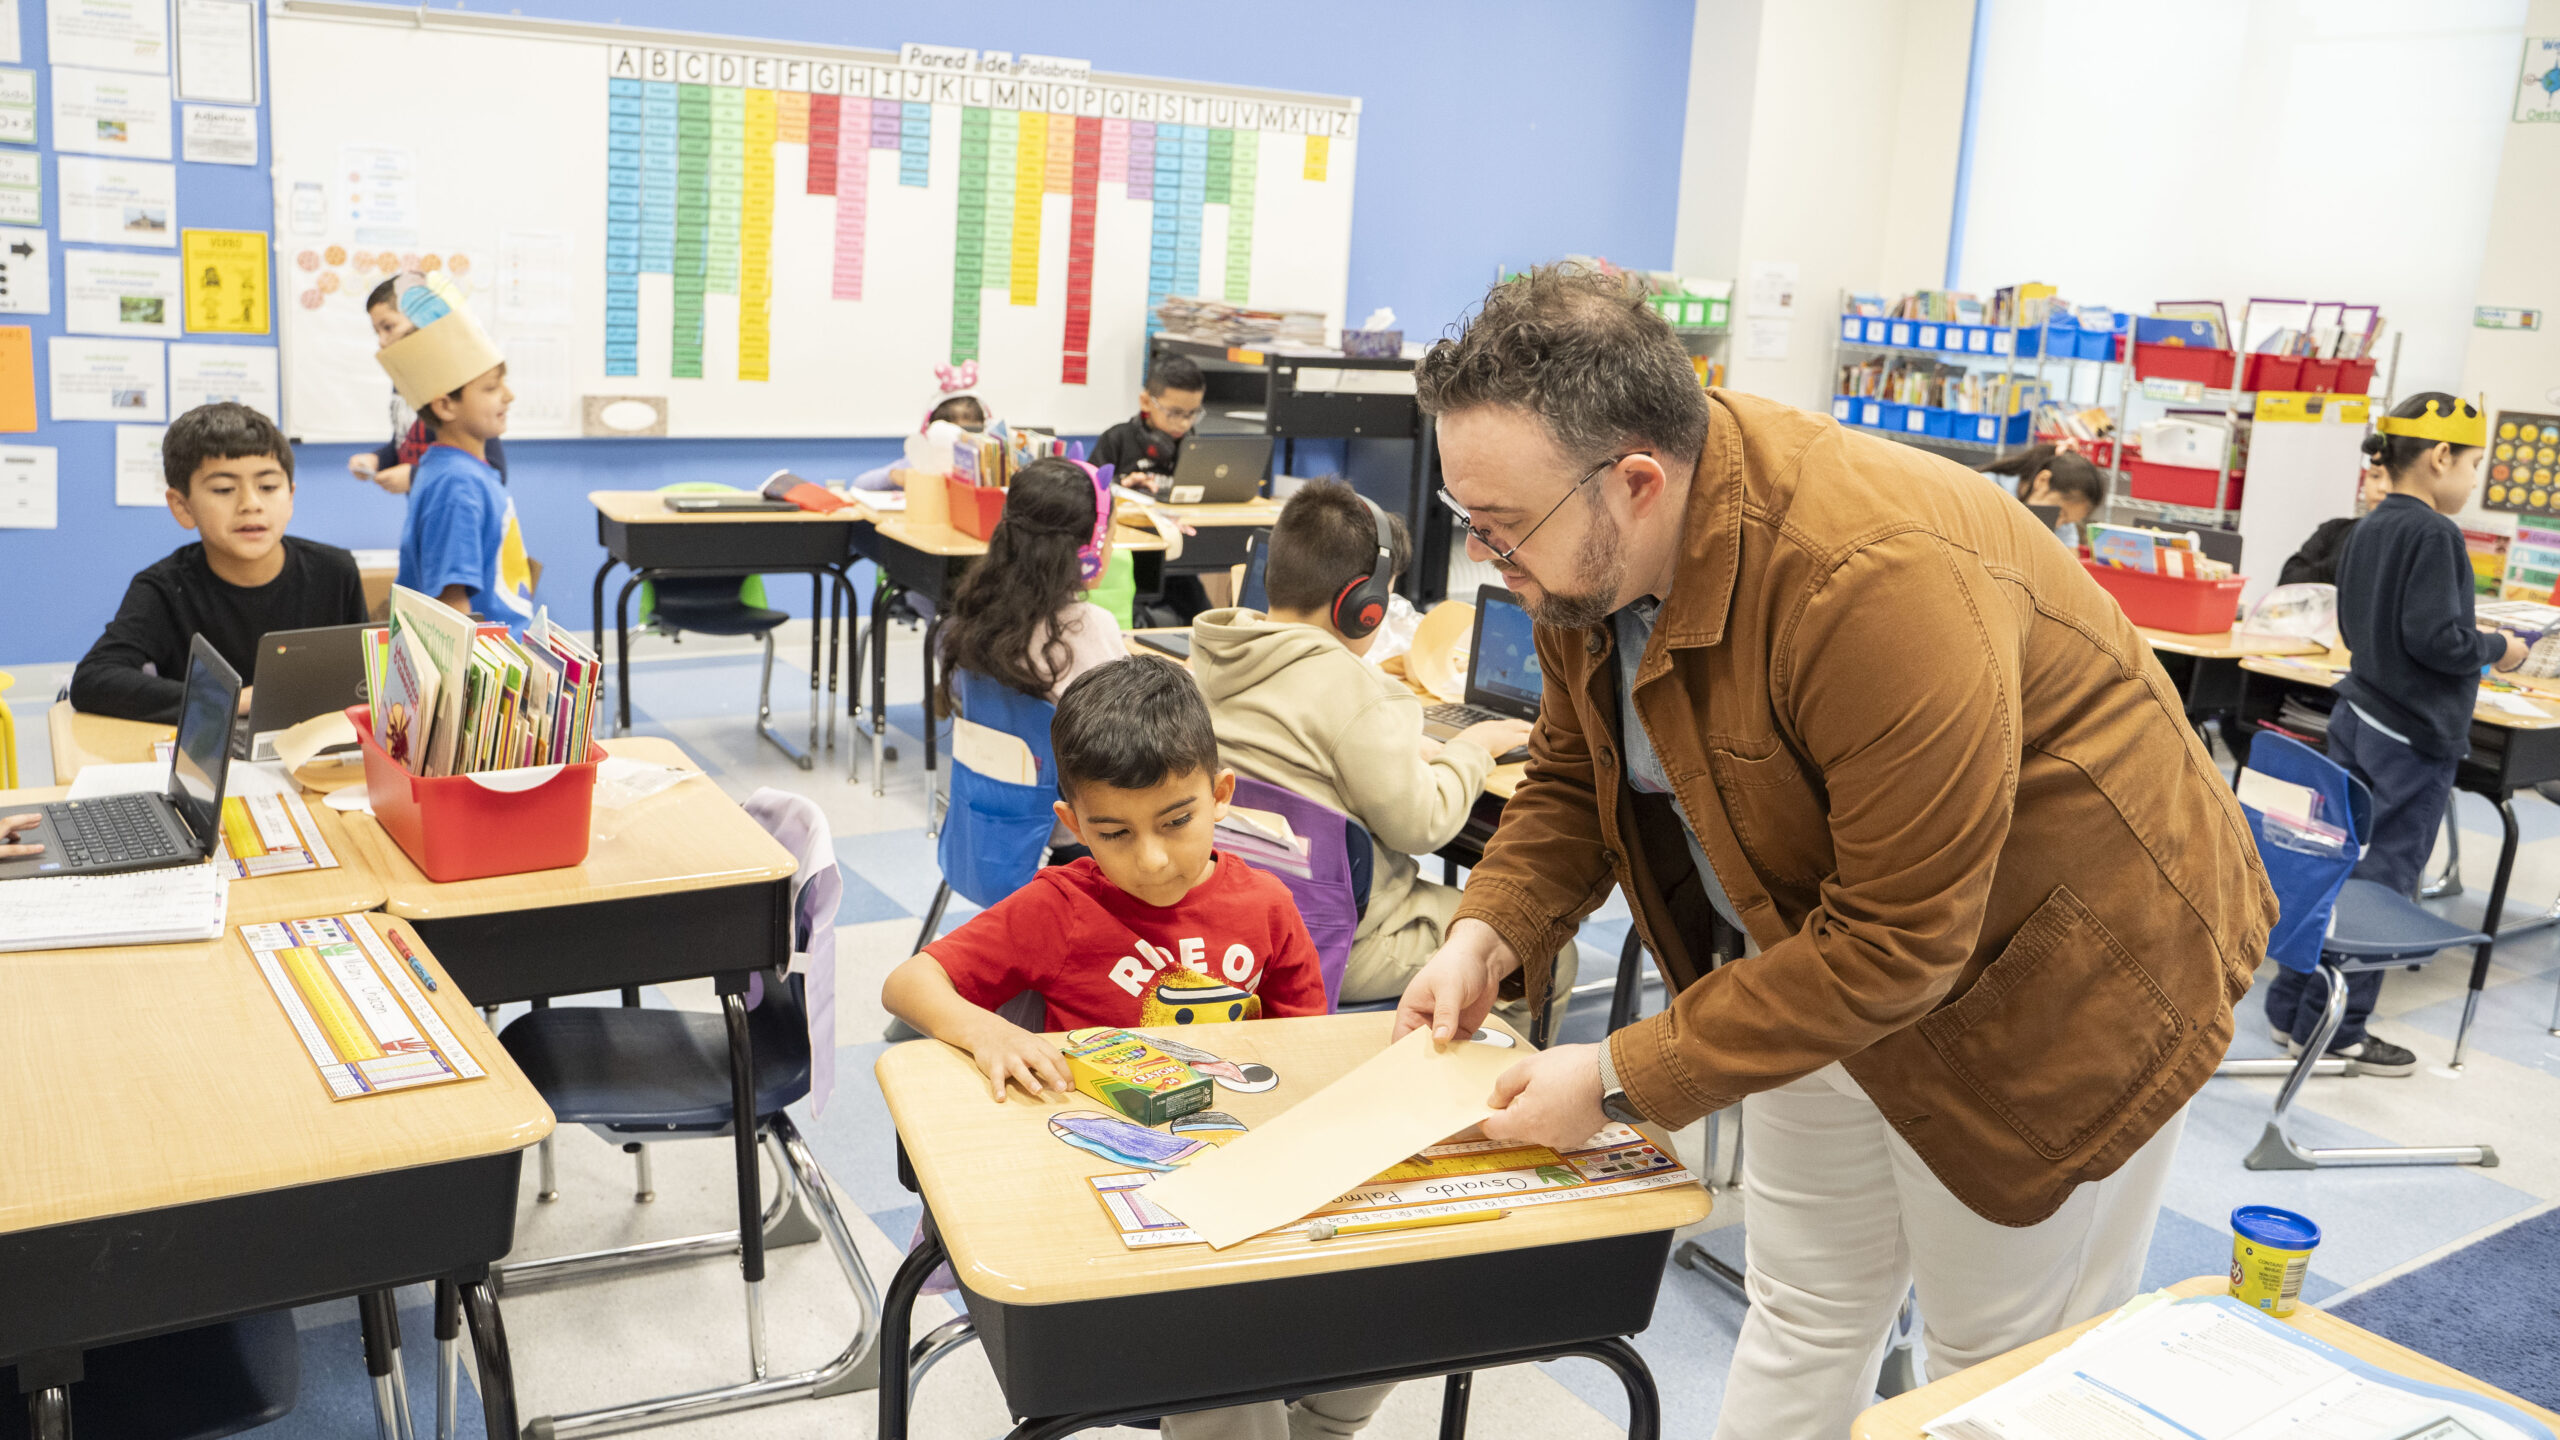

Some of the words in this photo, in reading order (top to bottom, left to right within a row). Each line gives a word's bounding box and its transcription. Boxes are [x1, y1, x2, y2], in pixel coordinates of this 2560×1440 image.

[909, 47, 967, 70] Pared
[985, 57, 1008, 73] de
[1019, 59, 1089, 80] Palabras
[617, 50, 634, 73] A
[652, 52, 667, 77] B
[686, 55, 701, 79] C
[720, 58, 735, 82] D
[754, 60, 768, 85] E
[788, 63, 804, 87] F
[817, 65, 834, 90] G
[850, 67, 864, 91] H
[882, 72, 893, 94] I
[908, 74, 923, 97] J
[940, 77, 953, 99] K
[969, 80, 982, 102] L
[996, 84, 1015, 104] M
[1028, 87, 1042, 106] N
[1054, 88, 1070, 109] O
[1084, 90, 1096, 111] P
[1110, 92, 1125, 114] Q
[1138, 94, 1150, 116] R
[1164, 96, 1177, 118] S
[1189, 98, 1203, 121] T
[1215, 101, 1228, 123] U
[1241, 103, 1255, 124] V
[1260, 104, 1280, 127] W
[1288, 107, 1302, 129] X
[1312, 109, 1325, 131] Y
[1335, 113, 1347, 134] Z
[1093, 1044, 1139, 1060] Crayola
[1131, 1065, 1185, 1084] CRAYONS
[1634, 1178, 1651, 1187] Cc
[1652, 1176, 1671, 1185] Bb
[1425, 1176, 1528, 1198] Osvaldo
[1600, 1183, 1617, 1192] Dd
[1543, 1191, 1564, 1200] Gg
[1432, 1205, 1456, 1213] Mm
[1327, 1216, 1348, 1225] Qq
[1352, 1214, 1370, 1222] Pp
